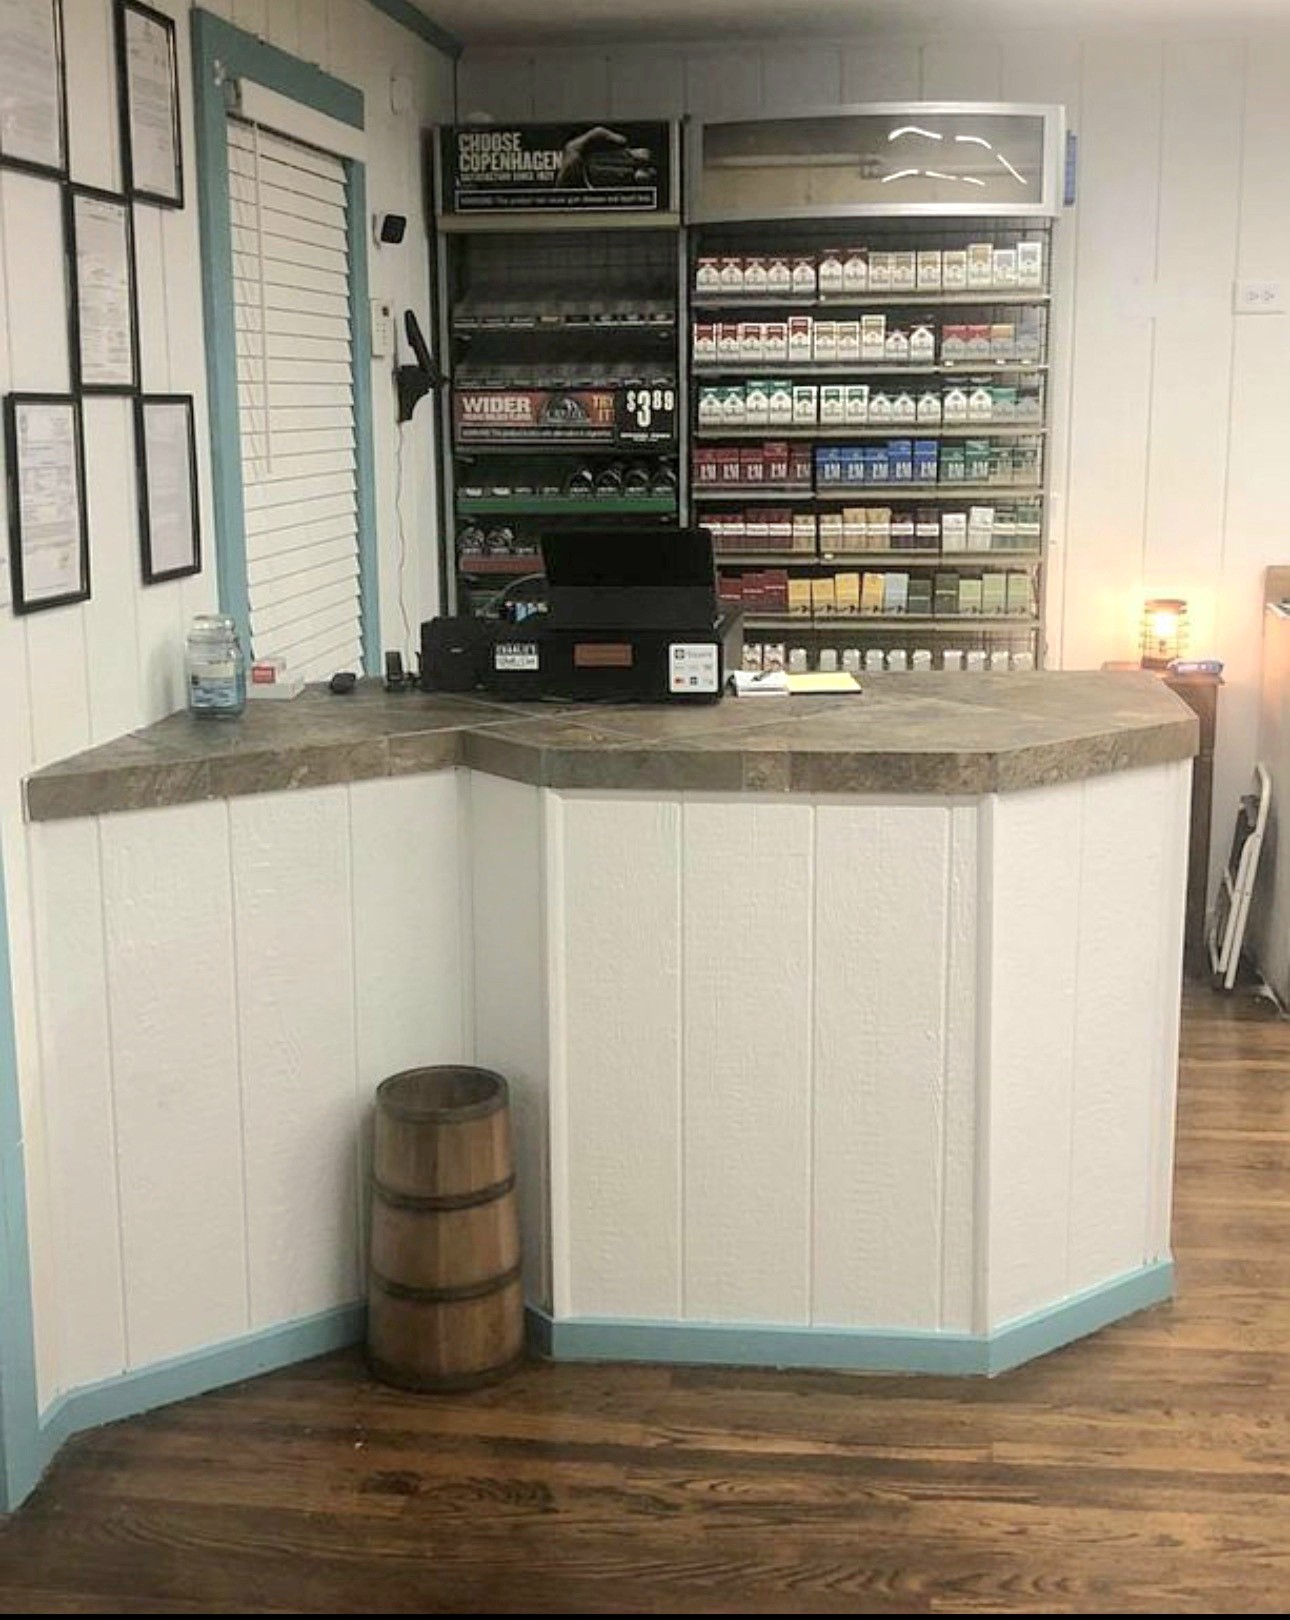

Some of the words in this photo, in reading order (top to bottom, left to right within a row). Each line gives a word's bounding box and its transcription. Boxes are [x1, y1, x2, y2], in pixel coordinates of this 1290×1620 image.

[458, 132, 523, 152] CHOOSE
[459, 150, 563, 172] COPENHAGEN
[462, 396, 531, 413] WIDER
